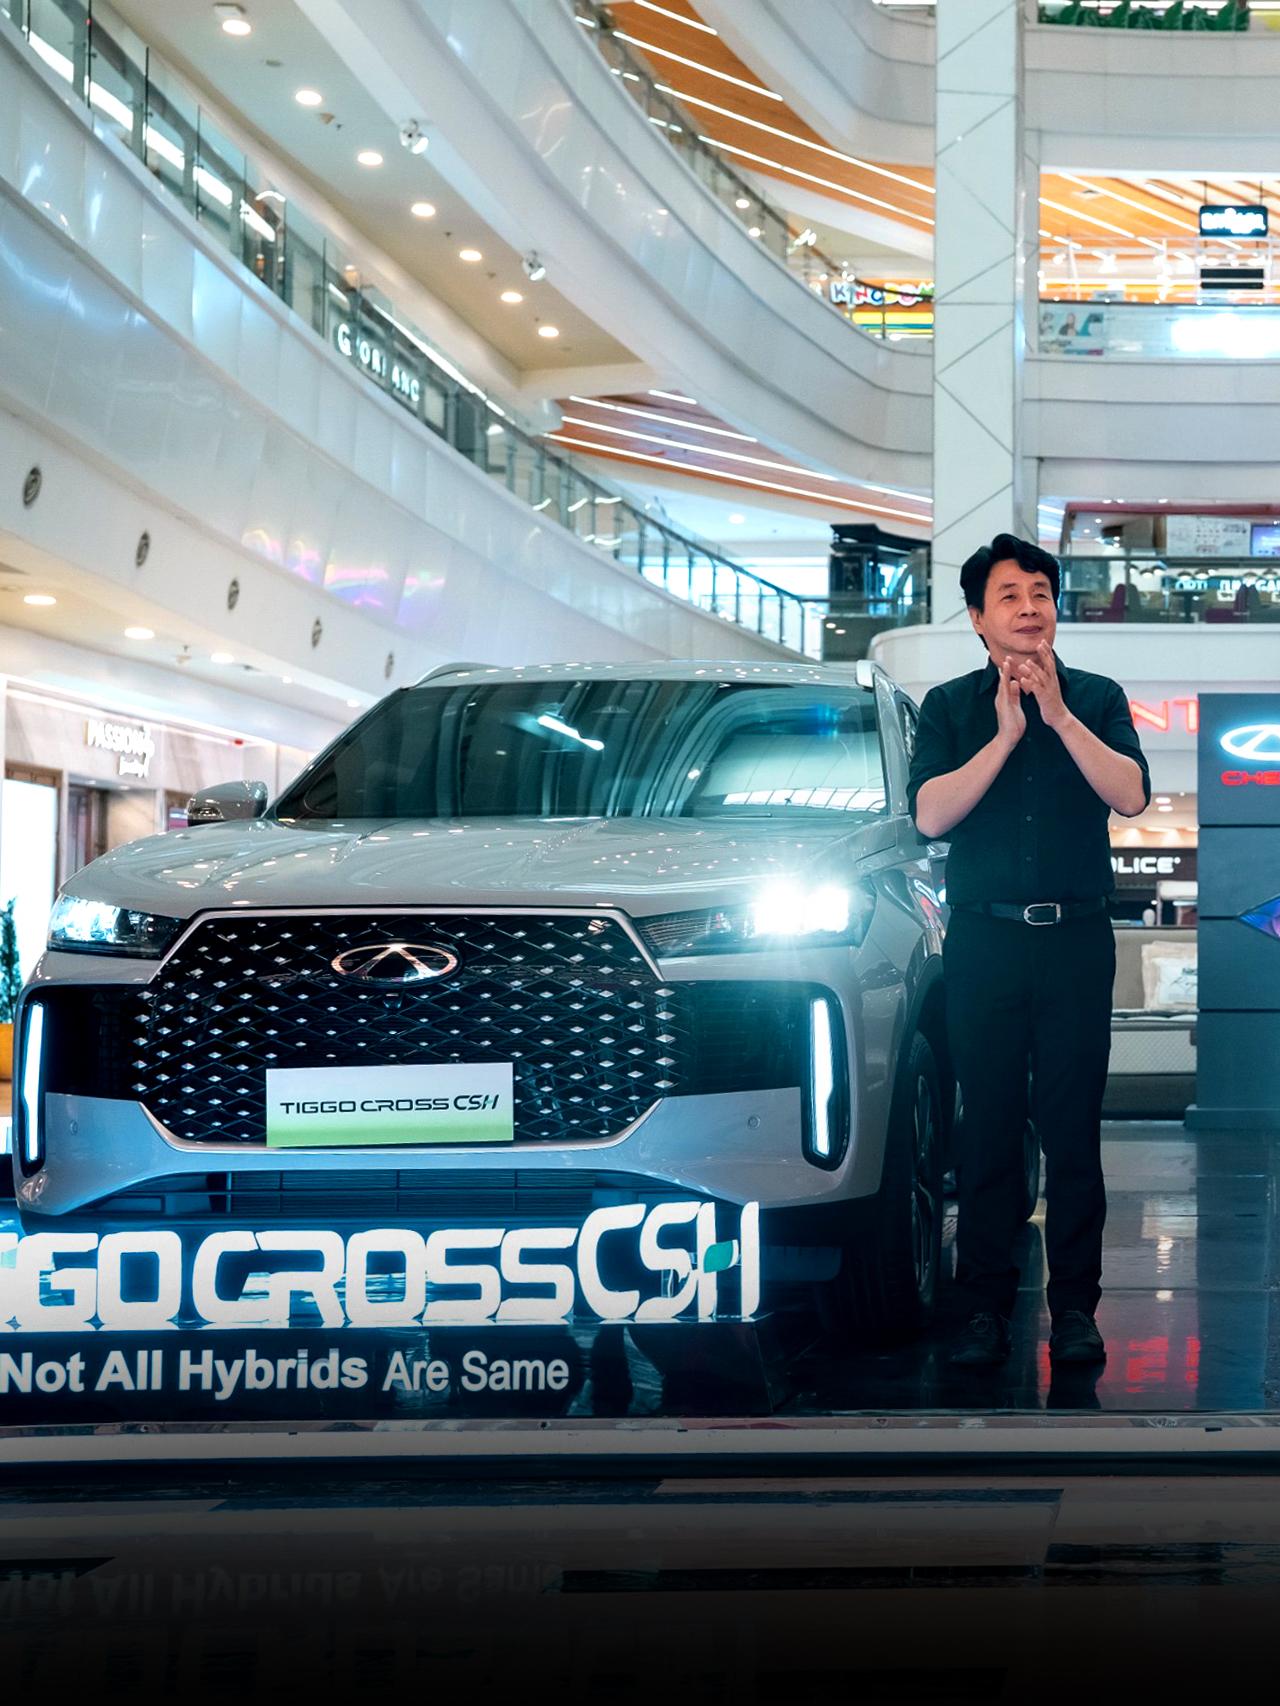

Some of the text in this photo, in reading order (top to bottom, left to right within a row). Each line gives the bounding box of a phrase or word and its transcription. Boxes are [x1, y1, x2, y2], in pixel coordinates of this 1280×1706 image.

[1110, 856, 1174, 874] LICE
[280, 1094, 500, 1114] TIGGO CROSS CSH
[0, 1201, 760, 1329] GO CROSS CSH
[0, 1347, 569, 1400] Not All Hybrids Are Same
